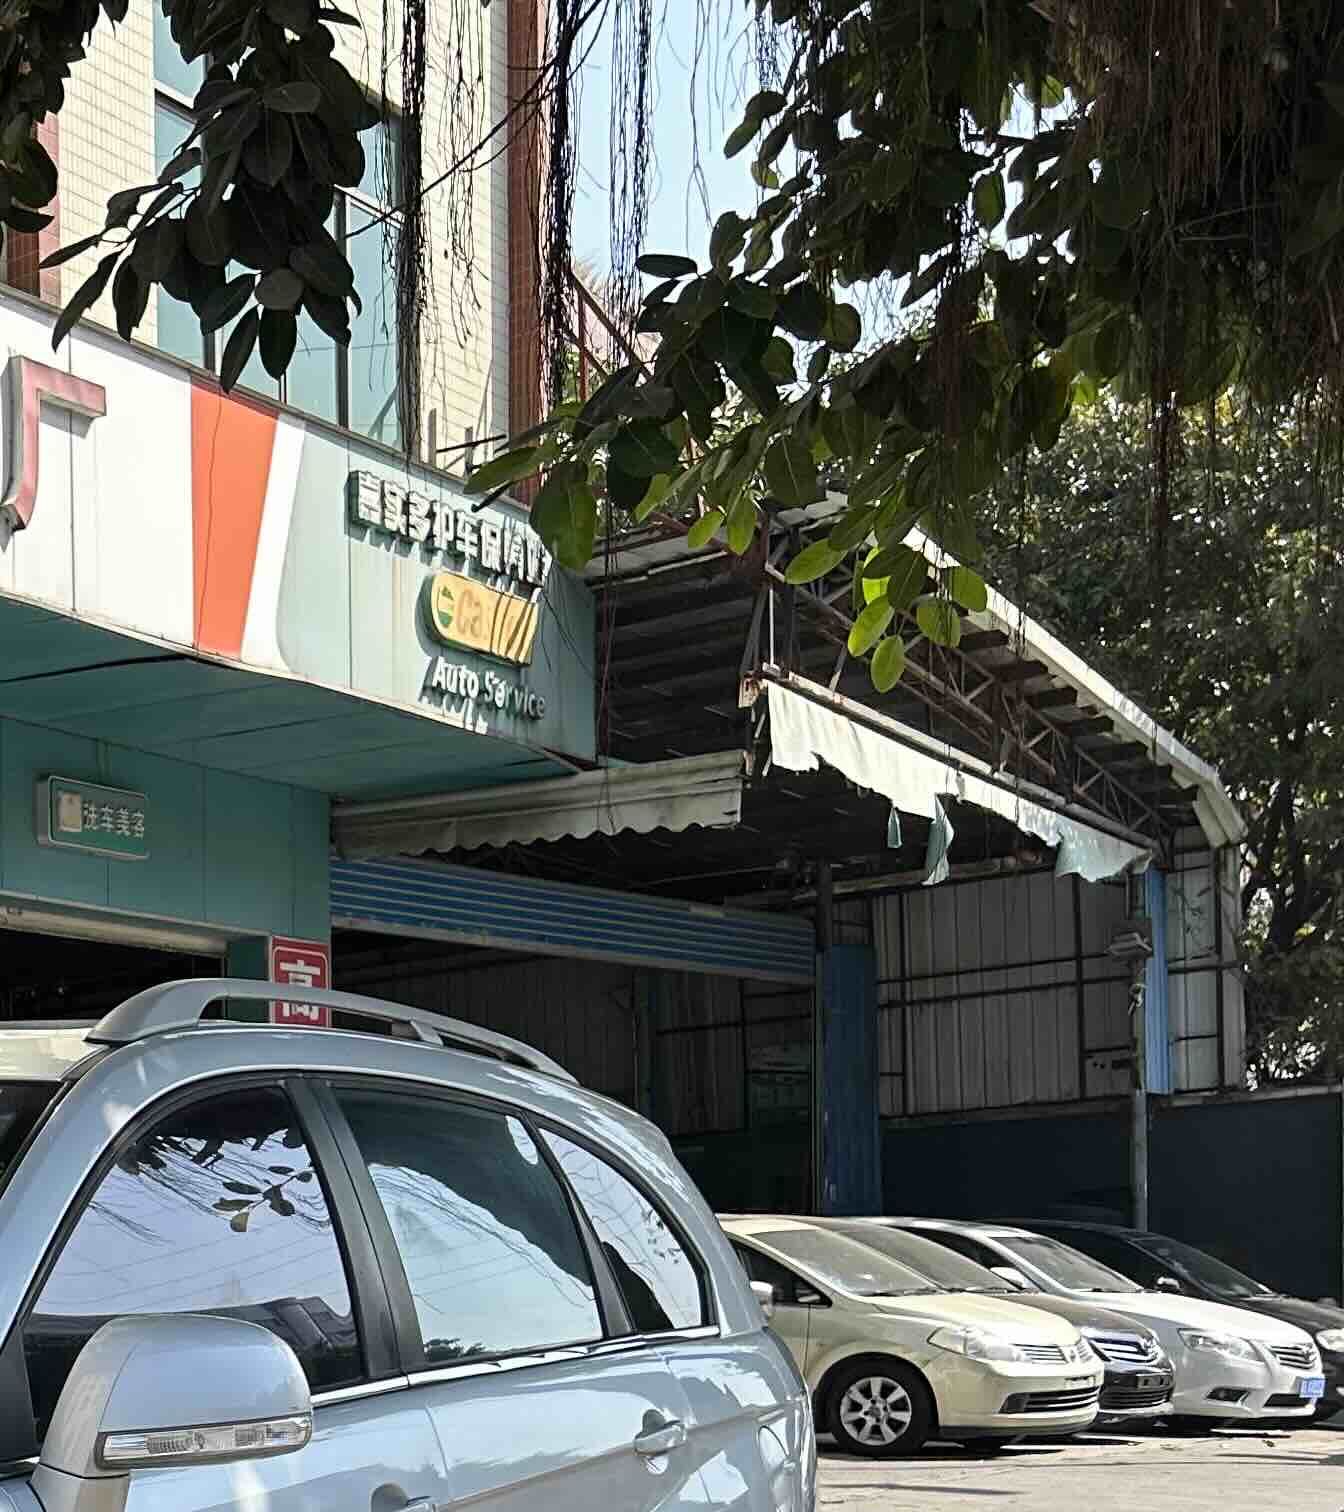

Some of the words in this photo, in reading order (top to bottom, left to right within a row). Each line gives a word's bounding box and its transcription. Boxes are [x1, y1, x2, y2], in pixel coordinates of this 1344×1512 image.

[431, 656, 480, 698] Auto
[484, 671, 545, 720] Service
[82, 800, 145, 839] 洗车美容
